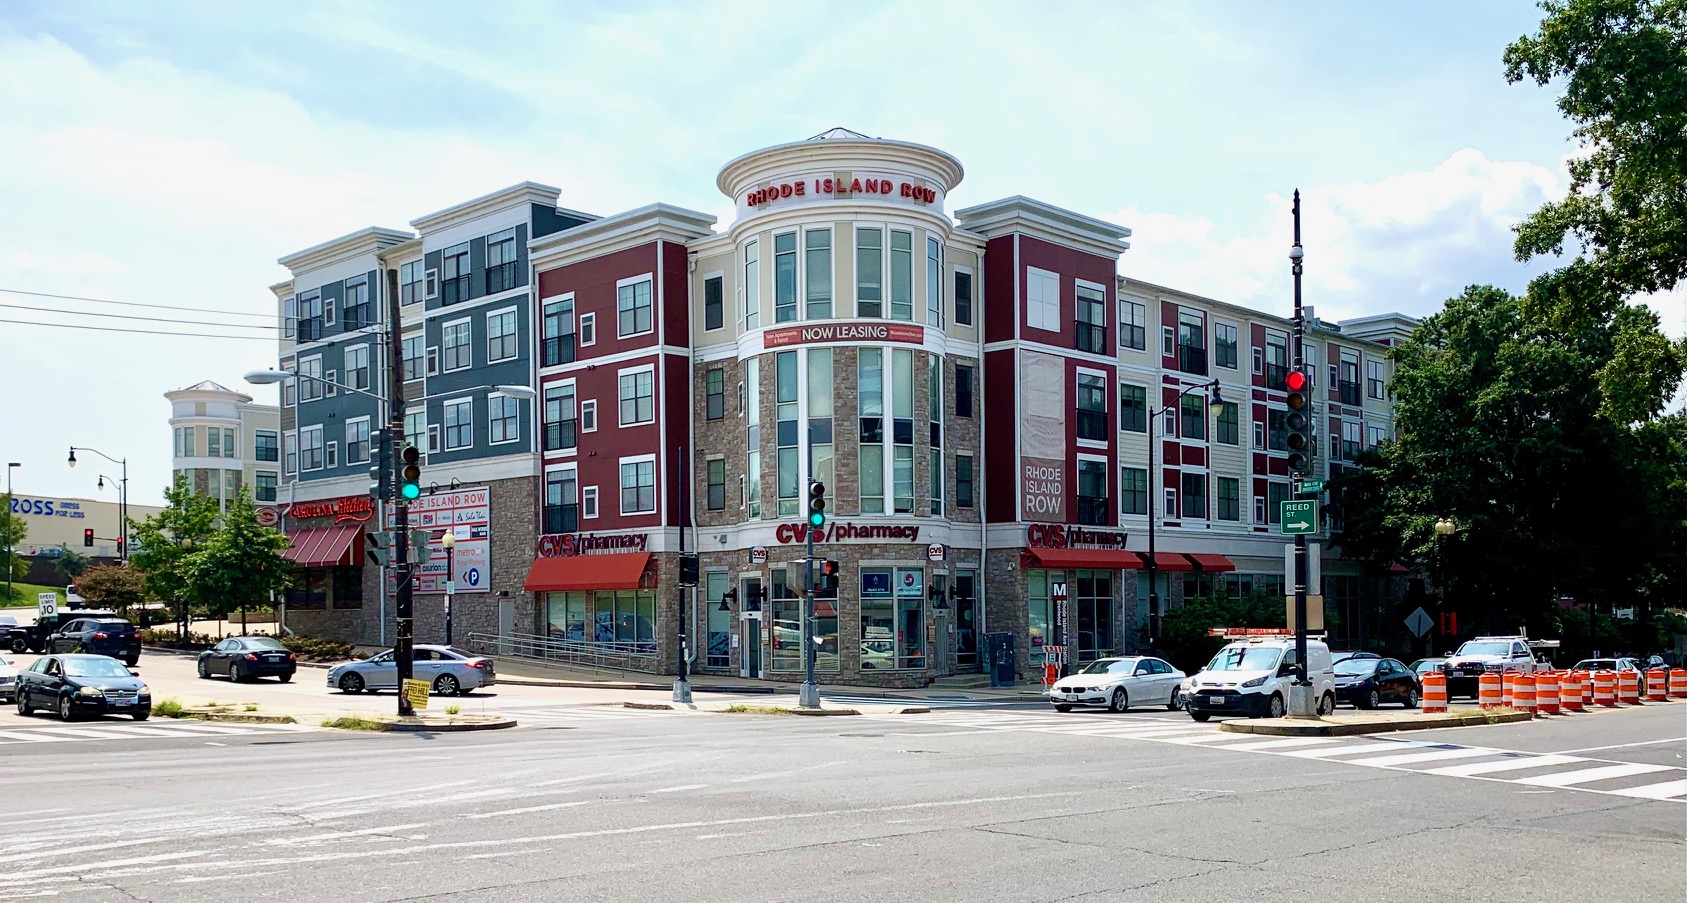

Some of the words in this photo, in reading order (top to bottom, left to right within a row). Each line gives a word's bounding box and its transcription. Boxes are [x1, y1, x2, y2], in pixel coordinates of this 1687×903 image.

[747, 180, 805, 207] RHODE
[815, 178, 894, 195] ISLAND
[901, 183, 936, 203] ROW
[802, 327, 834, 340] NOW
[837, 326, 888, 338] LEASING
[1025, 465, 1062, 481] RHODE
[1025, 481, 1062, 495] ISLAND
[427, 495, 459, 507] ISLAND
[464, 493, 486, 504] ROW
[1026, 495, 1061, 513] ROW
[1286, 503, 1309, 511] REED
[290, 504, 334, 518] CAROLINA
[336, 497, 373, 519] Kitchen
[1028, 524, 1128, 548] CVS/pharmacy
[538, 532, 648, 557] CVS/pharmacy
[457, 548, 475, 556] metro
[422, 563, 441, 572] asurion
[472, 572, 478, 583] P
[1053, 583, 1066, 596] M
[42, 605, 54, 614] 10
